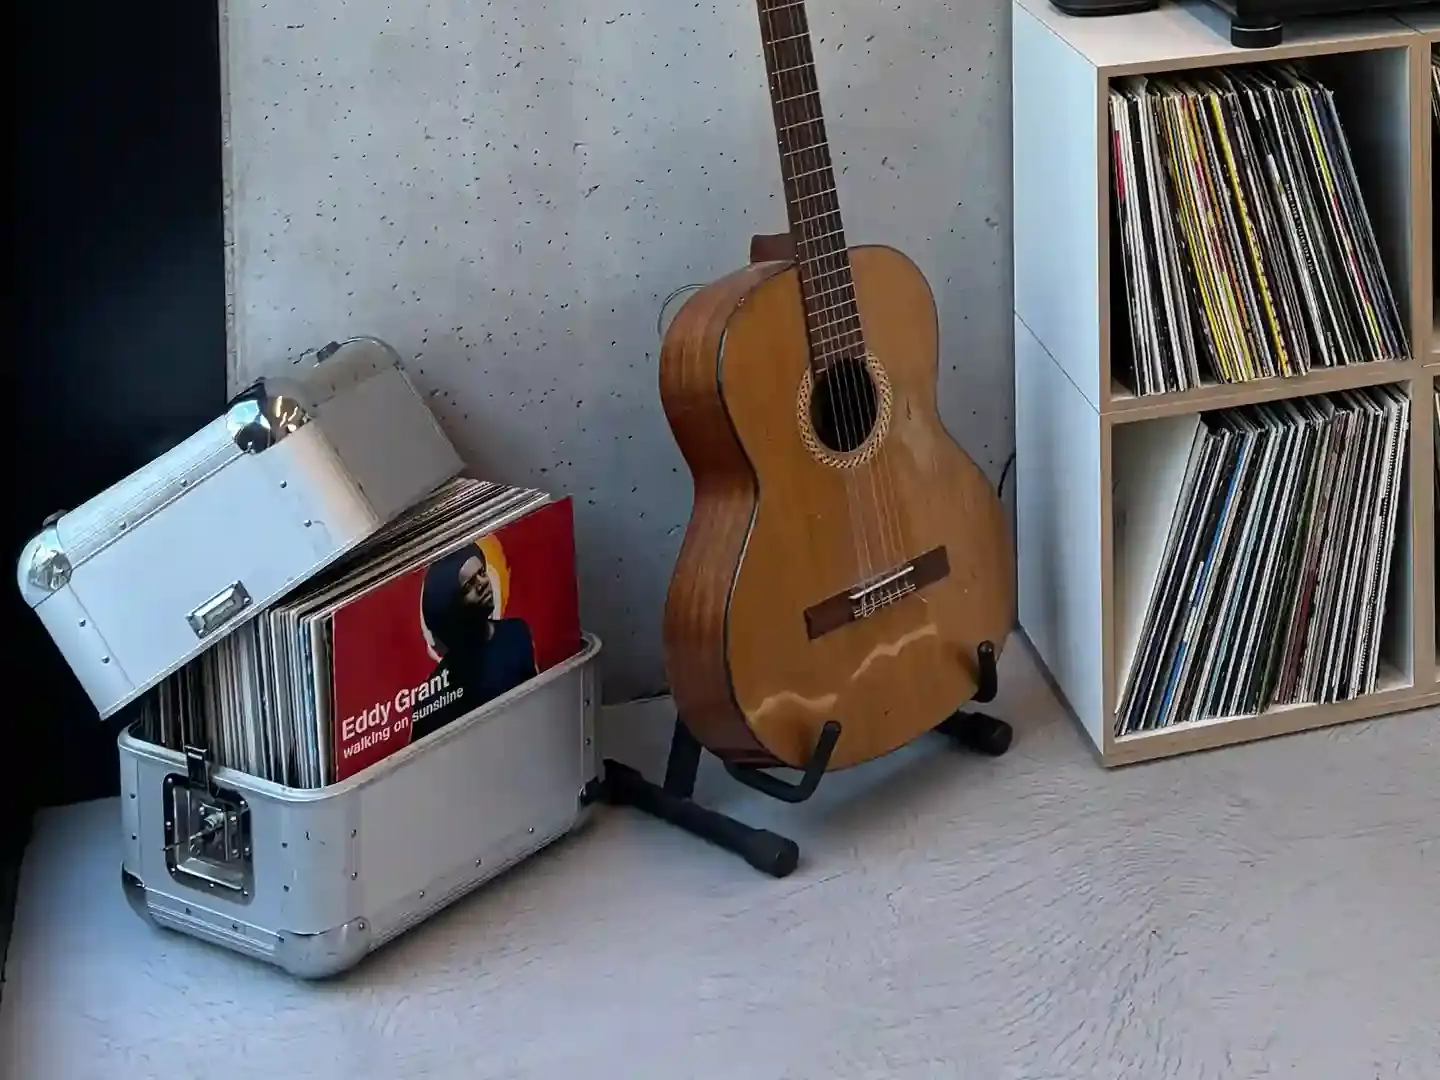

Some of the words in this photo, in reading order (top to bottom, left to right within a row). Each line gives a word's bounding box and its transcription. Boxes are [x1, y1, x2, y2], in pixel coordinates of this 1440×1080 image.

[342, 700, 391, 741] Eddy
[394, 668, 450, 713] Grant
[343, 726, 390, 759] walking
[393, 716, 409, 733] on
[412, 687, 465, 722] sunshine
